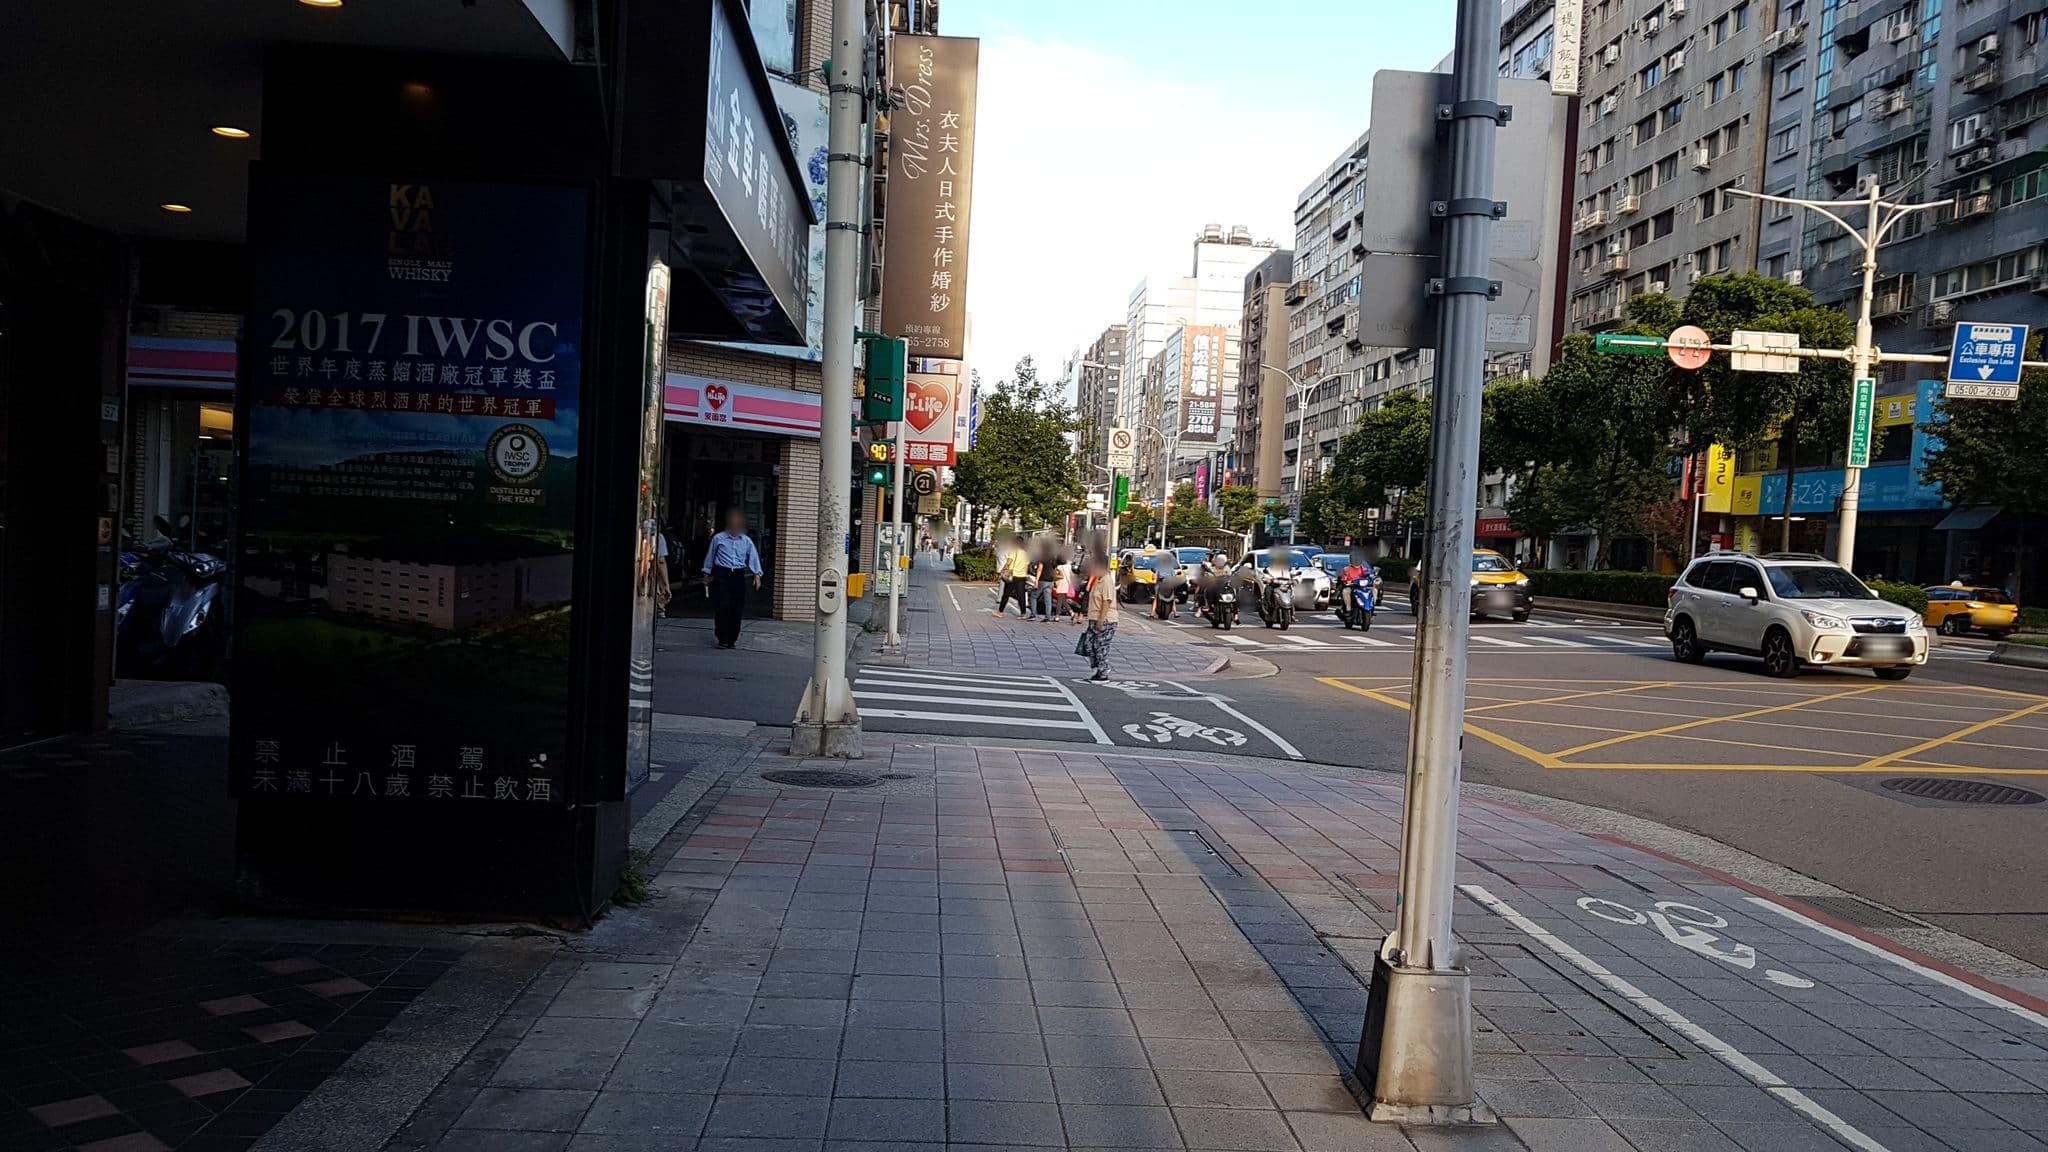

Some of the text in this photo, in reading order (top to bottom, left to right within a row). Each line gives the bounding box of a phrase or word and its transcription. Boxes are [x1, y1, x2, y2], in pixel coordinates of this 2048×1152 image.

[900, 45, 934, 179] Mrs. Dress
[930, 110, 960, 312] 衣夫人日式手作婚紗
[387, 266, 453, 281] WHISKY
[270, 308, 558, 363] 2017 IWSC
[1960, 341, 2016, 358] 公車專用
[270, 356, 557, 391] 世界年度蒸餾酒廠冠軍獎盃
[1955, 386, 1979, 395] 05:00
[1986, 387, 2011, 397] 24:00
[283, 387, 542, 417] 榮登全球烈酒界的世界冠軍
[504, 451, 530, 461] IWSC
[870, 443, 887, 460] 90
[503, 460, 531, 468] TROPHY
[490, 487, 530, 496] DISTILLER
[496, 494, 536, 505] THE YEAR
[427, 774, 552, 802] 禁止飲酒
